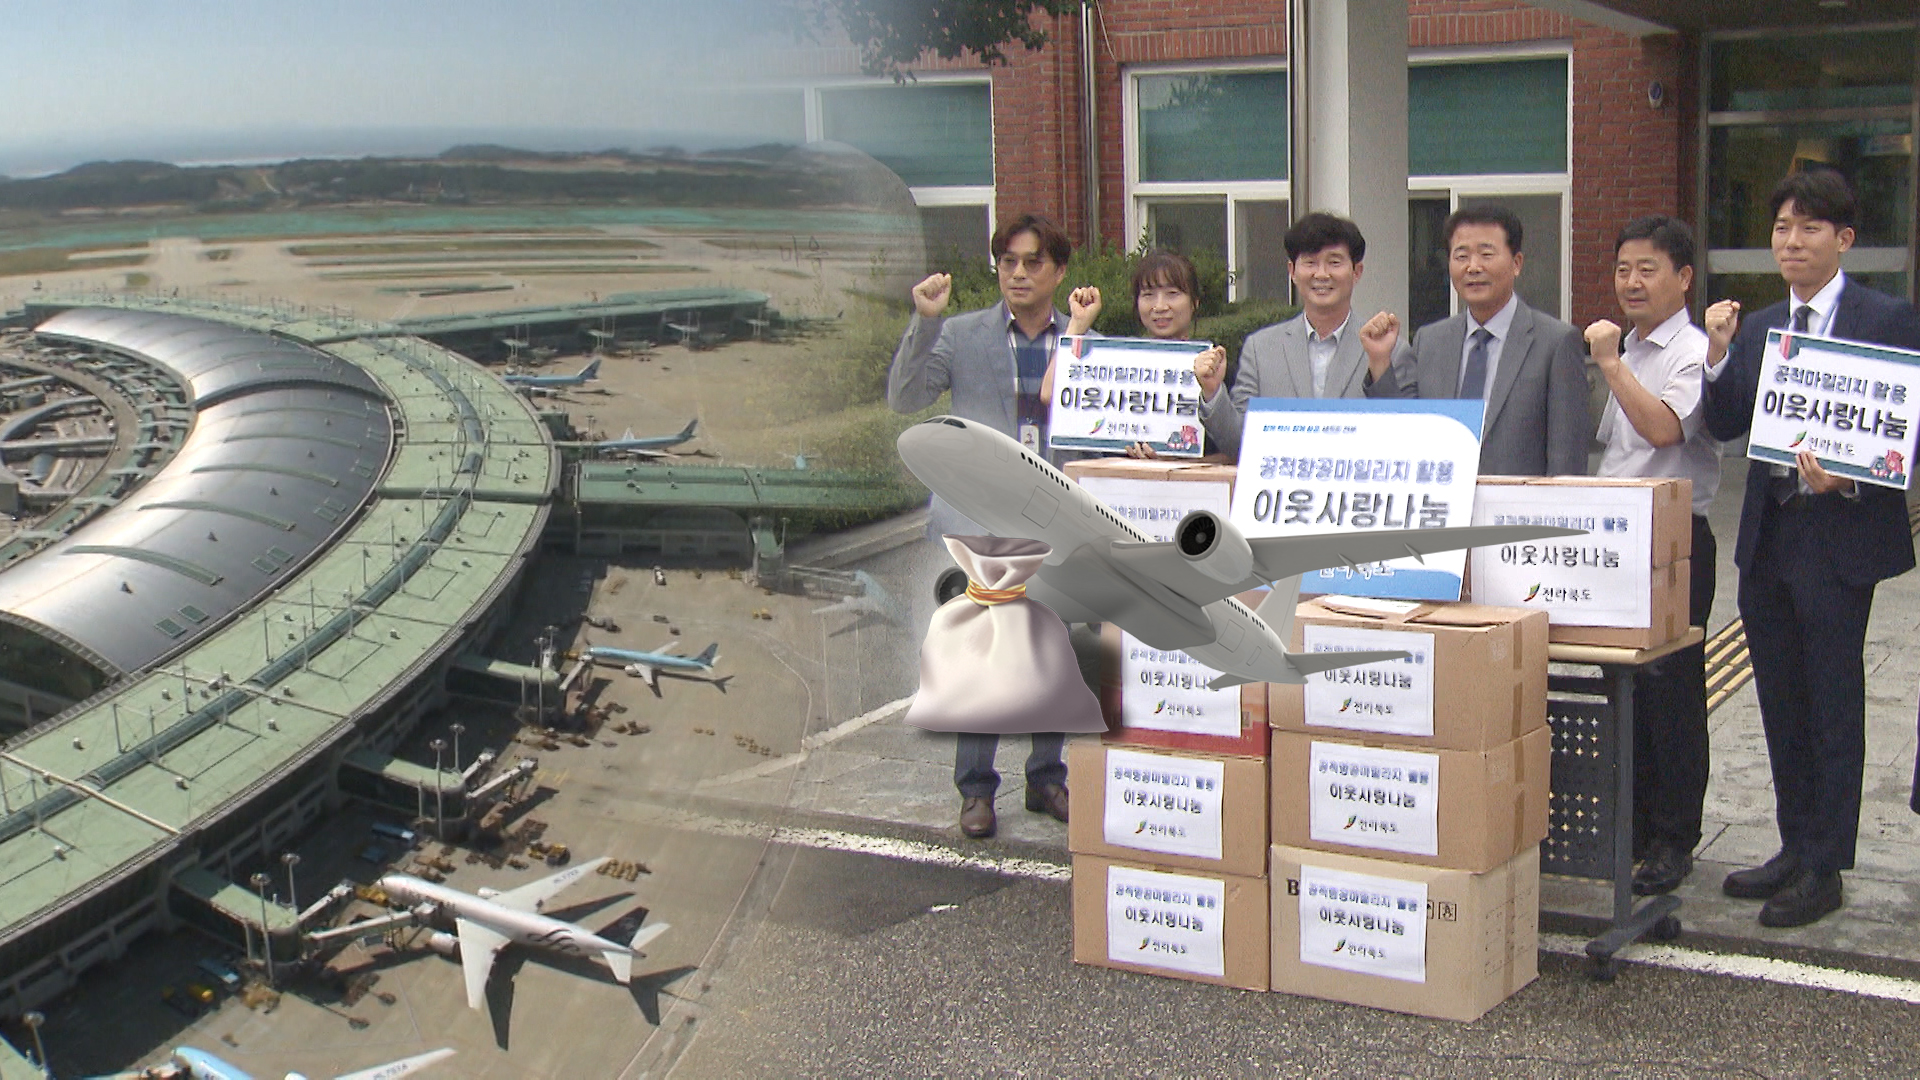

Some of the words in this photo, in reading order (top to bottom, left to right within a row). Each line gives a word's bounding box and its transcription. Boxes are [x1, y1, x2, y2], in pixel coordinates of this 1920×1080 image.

[1068, 363, 1158, 385] 공적마일리지
[1162, 369, 1196, 387] 활용
[1774, 365, 1868, 398] 공적마일리지
[1872, 381, 1908, 404] 활용
[1060, 387, 1198, 416] 이웃사랑나눔
[1764, 389, 1908, 440] 이웃사랑나눔
[1260, 456, 1411, 484] 공적항공마일리지
[1416, 460, 1455, 485] 활용
[1253, 488, 1450, 530] 이웃사랑나눔
[1500, 545, 1620, 568] 이웃사랑나눔
[1542, 586, 1593, 602] 전라북도
